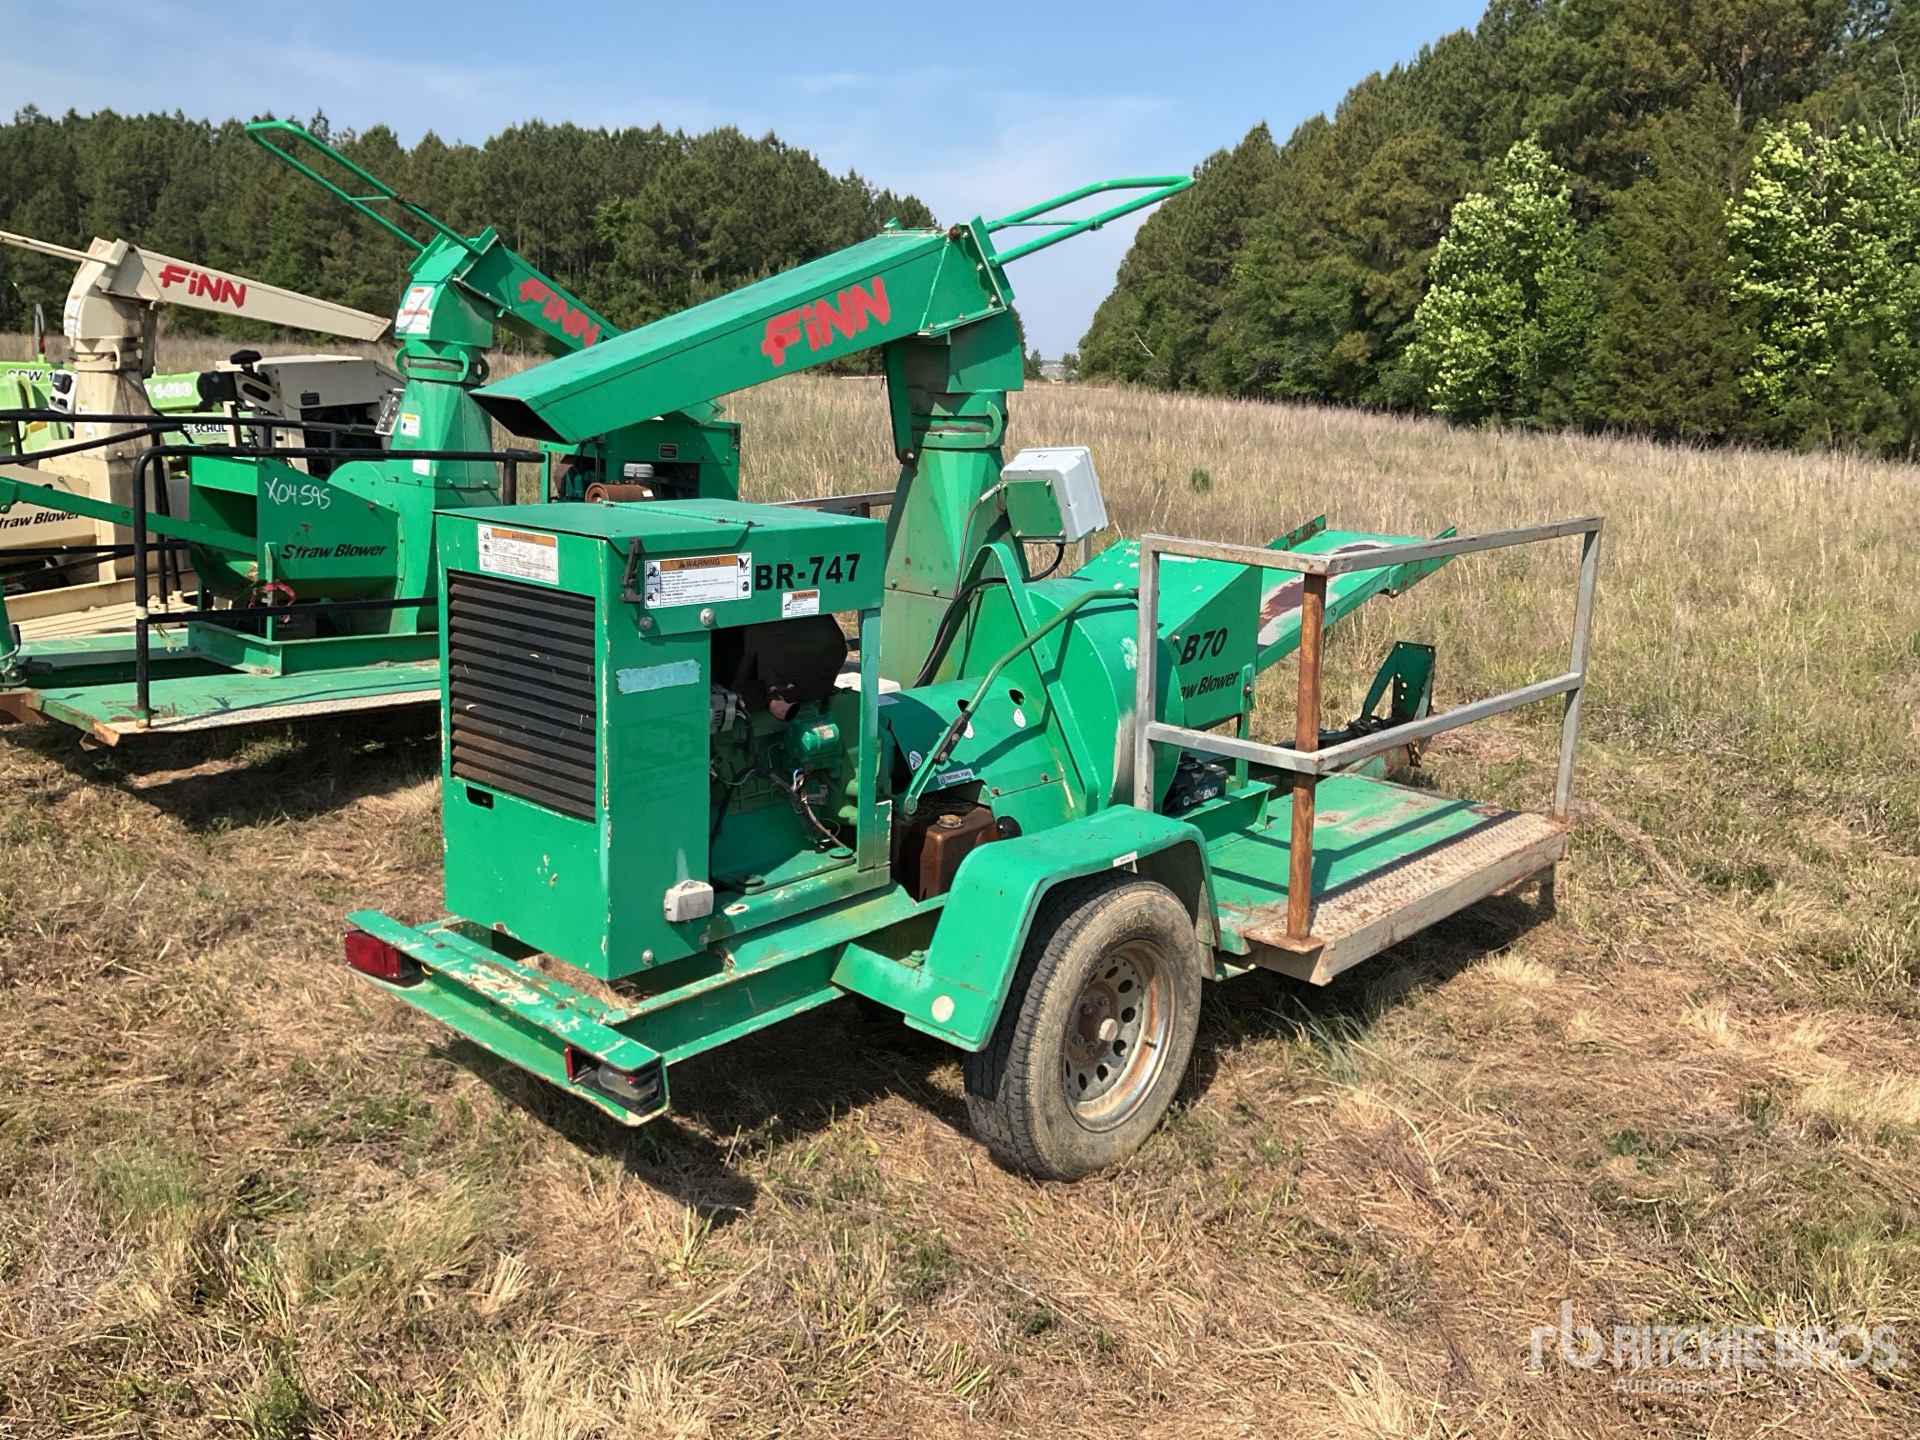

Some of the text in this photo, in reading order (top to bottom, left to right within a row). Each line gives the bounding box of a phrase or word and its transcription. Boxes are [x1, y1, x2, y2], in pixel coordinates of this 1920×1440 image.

[0, 516, 32, 529] traw
[281, 544, 388, 559] Straw Blower
[687, 558, 721, 568] WARNING
[755, 553, 860, 591] BR-747
[1197, 671, 1240, 696] Blower
